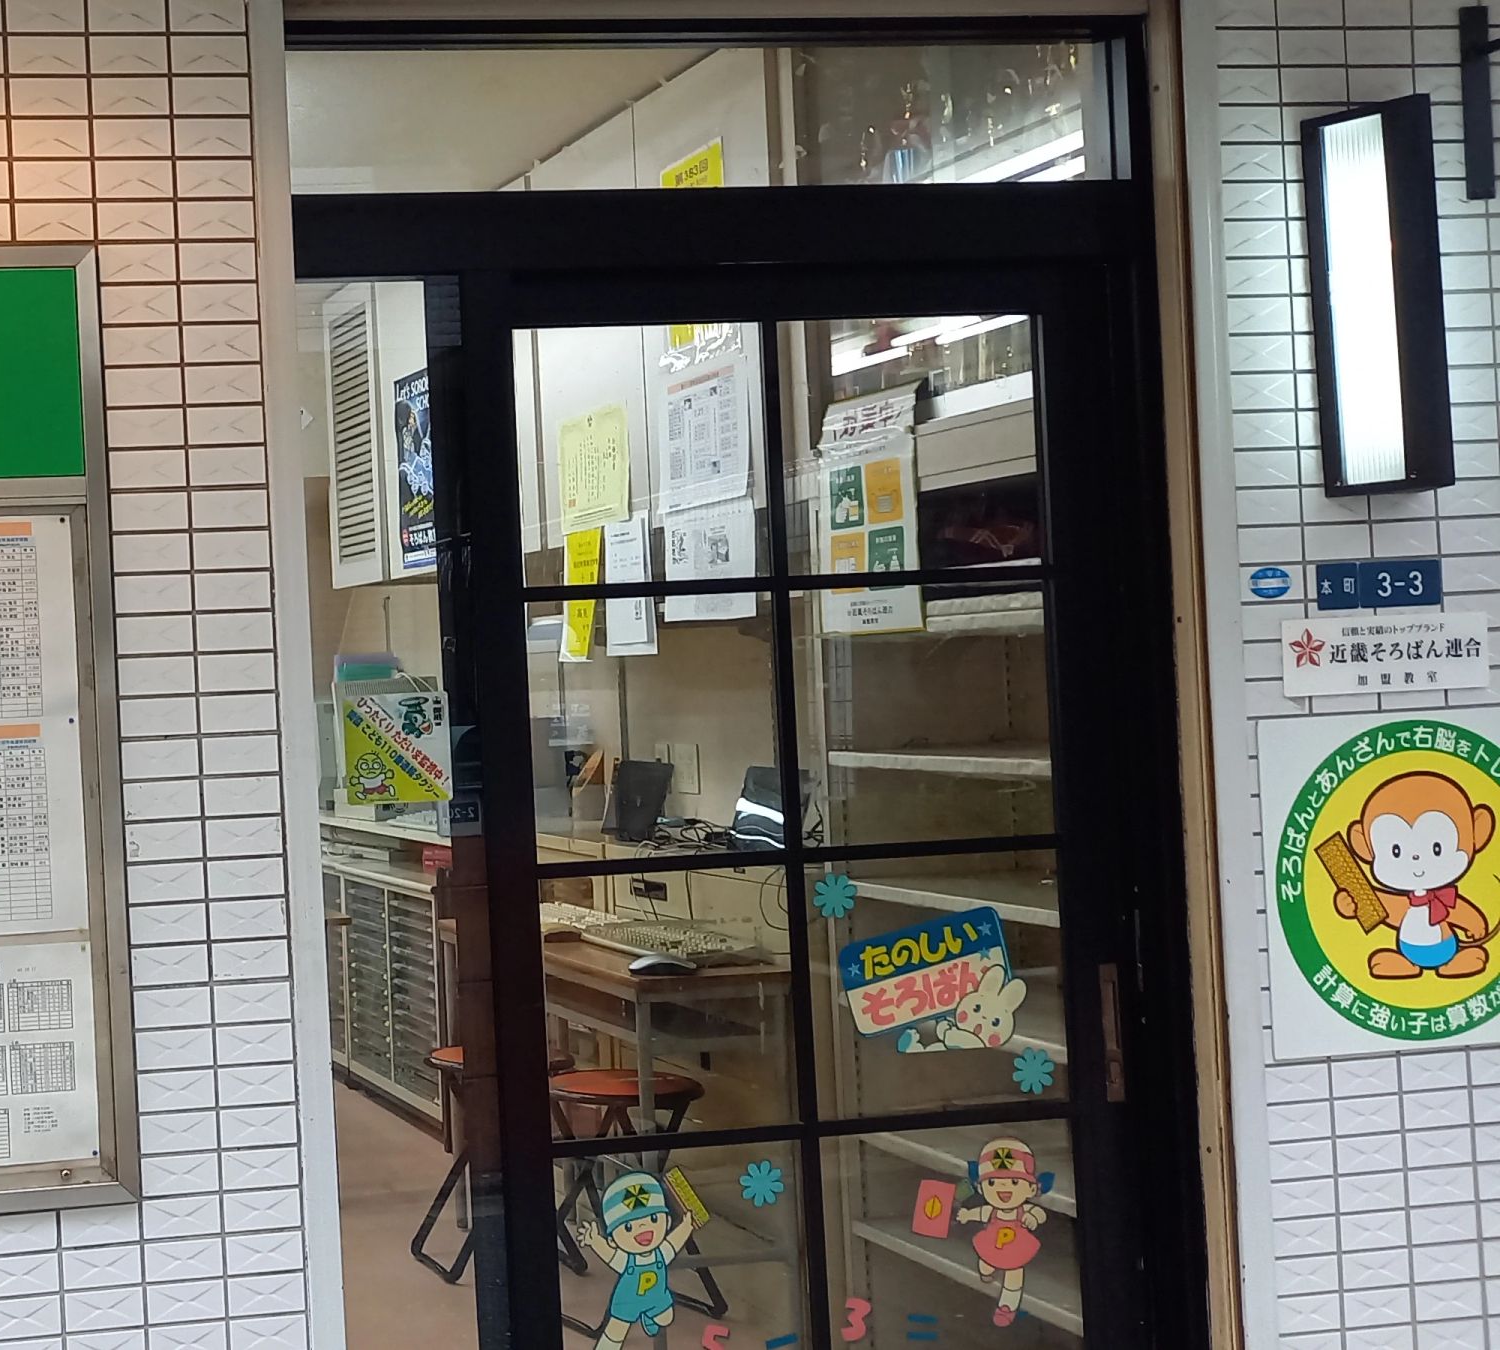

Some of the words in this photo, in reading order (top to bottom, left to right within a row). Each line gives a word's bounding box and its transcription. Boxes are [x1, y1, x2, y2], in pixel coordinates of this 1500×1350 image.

[1320, 577, 1355, 596] 本町
[1377, 570, 1424, 598] 3-3
[1329, 636, 1482, 665] 近畿そろばん連合
[1357, 670, 1438, 686] 加盟教室
[357, 697, 395, 733] ひったくり
[860, 922, 979, 981] たのしい
[861, 961, 990, 1027] そろばん
[996, 1226, 1016, 1250] P
[636, 1271, 658, 1297] P
[841, 1297, 873, 1342] 3
